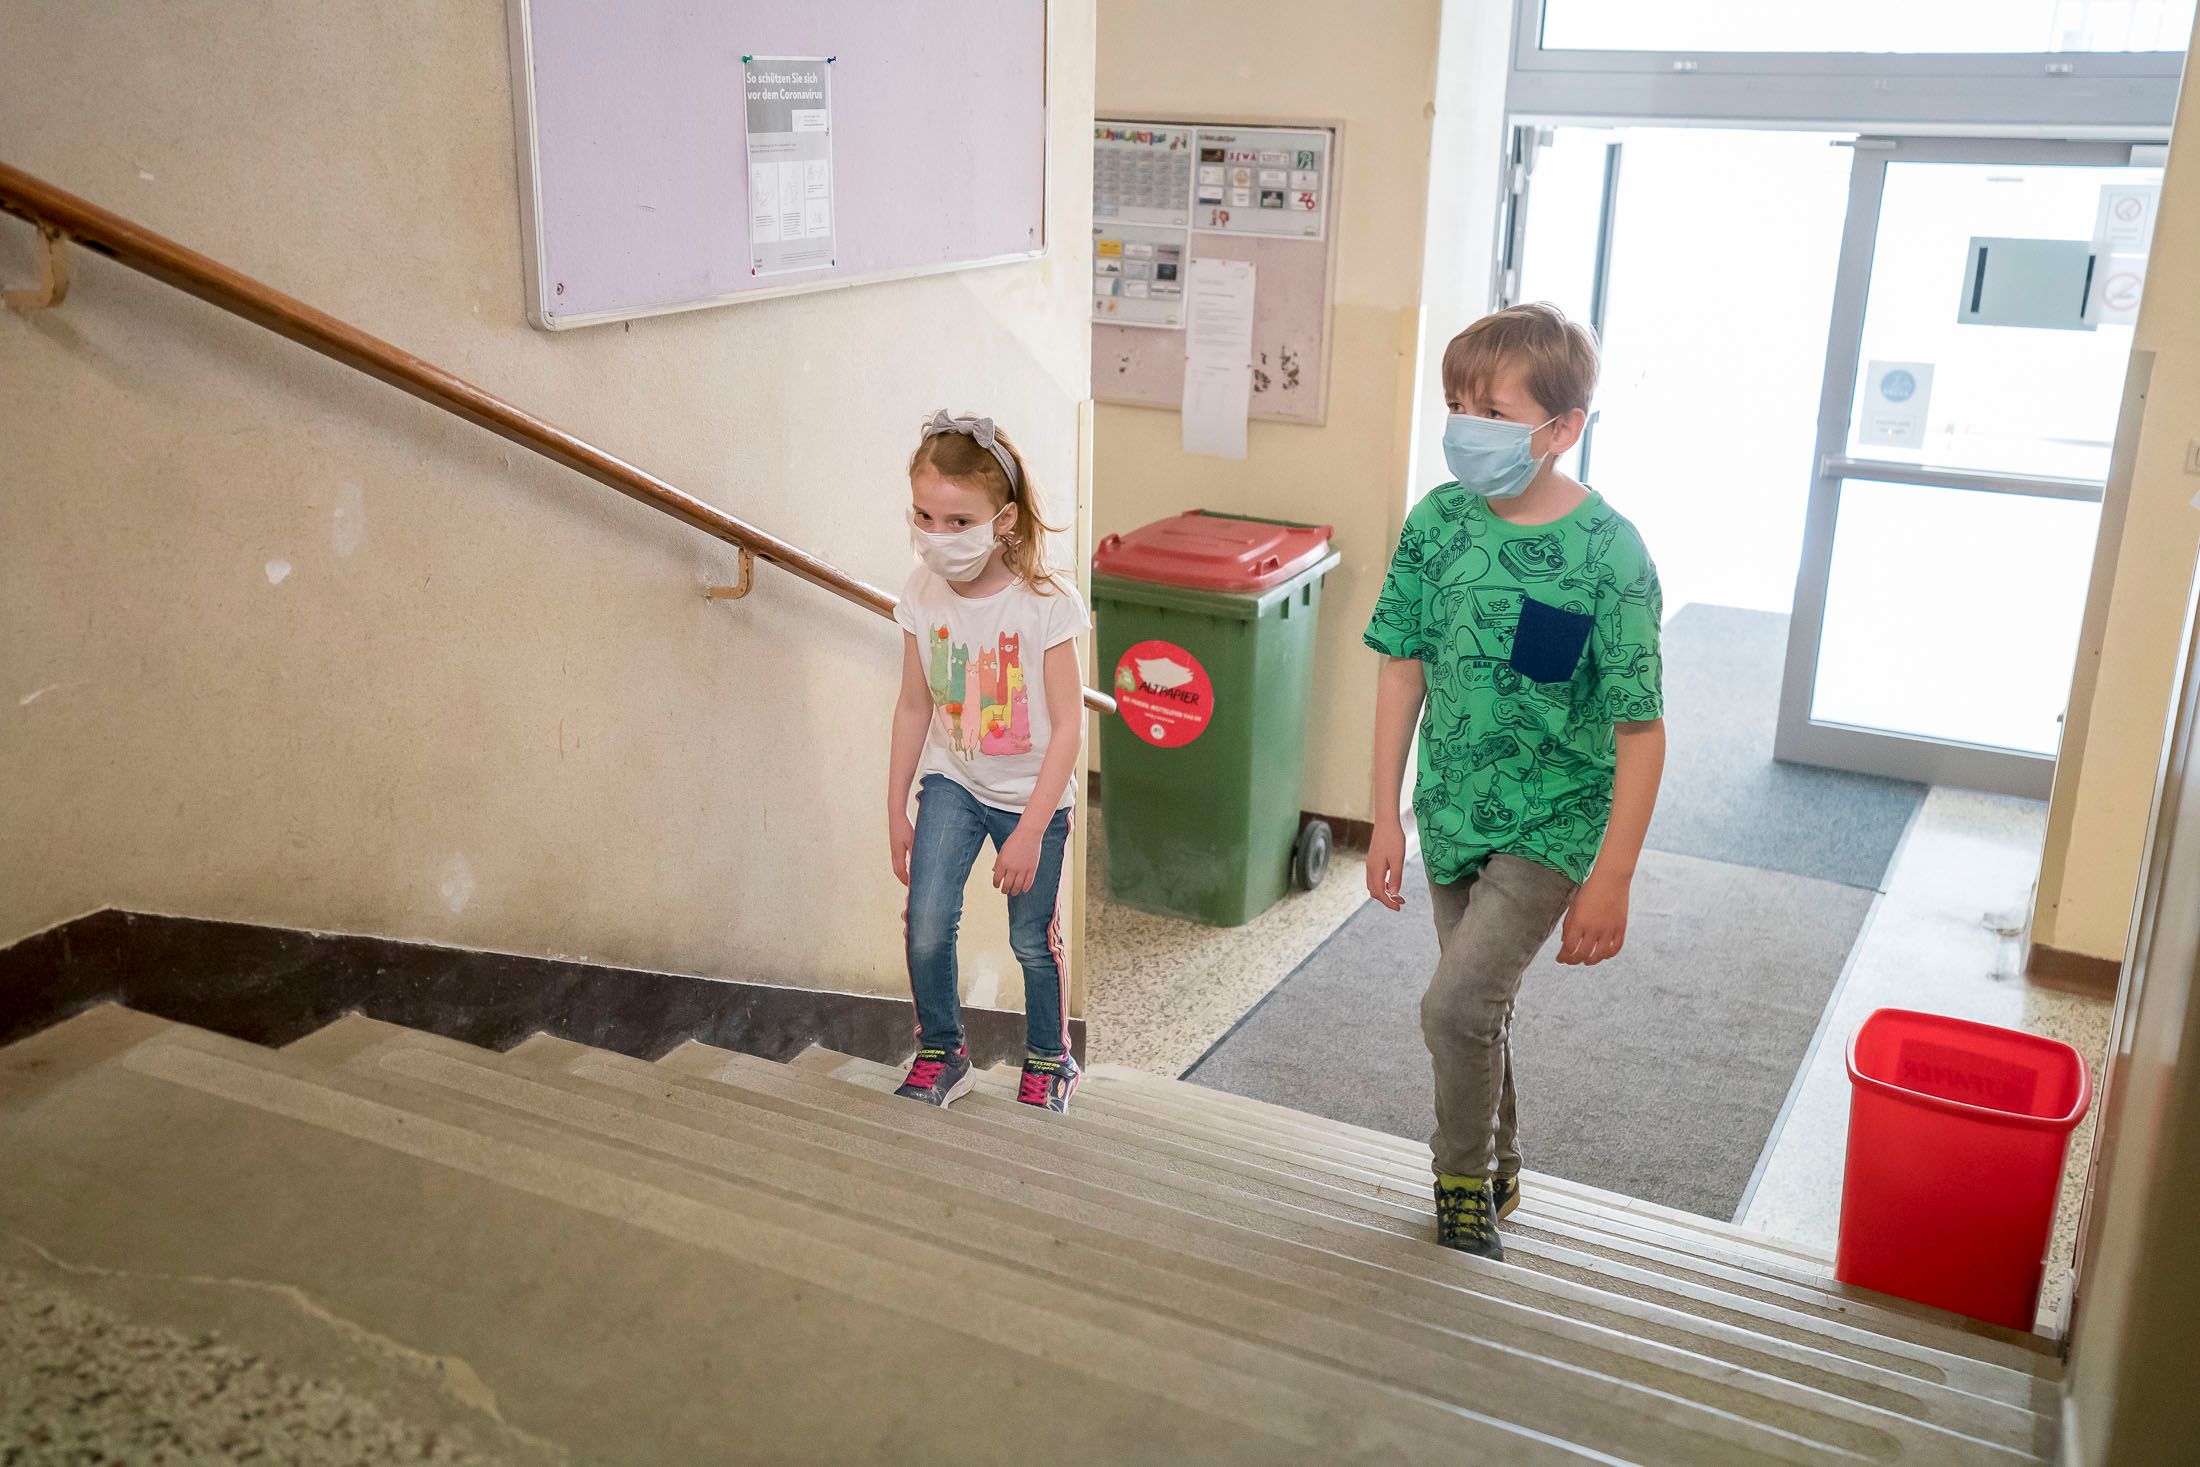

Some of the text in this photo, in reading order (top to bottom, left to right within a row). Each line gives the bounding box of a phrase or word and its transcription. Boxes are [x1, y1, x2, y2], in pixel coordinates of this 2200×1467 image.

[746, 72, 818, 84] So schützen Sie sich
[747, 88, 823, 100] vor dem Coronavirus
[1139, 681, 1200, 706] ALTPAPIER
